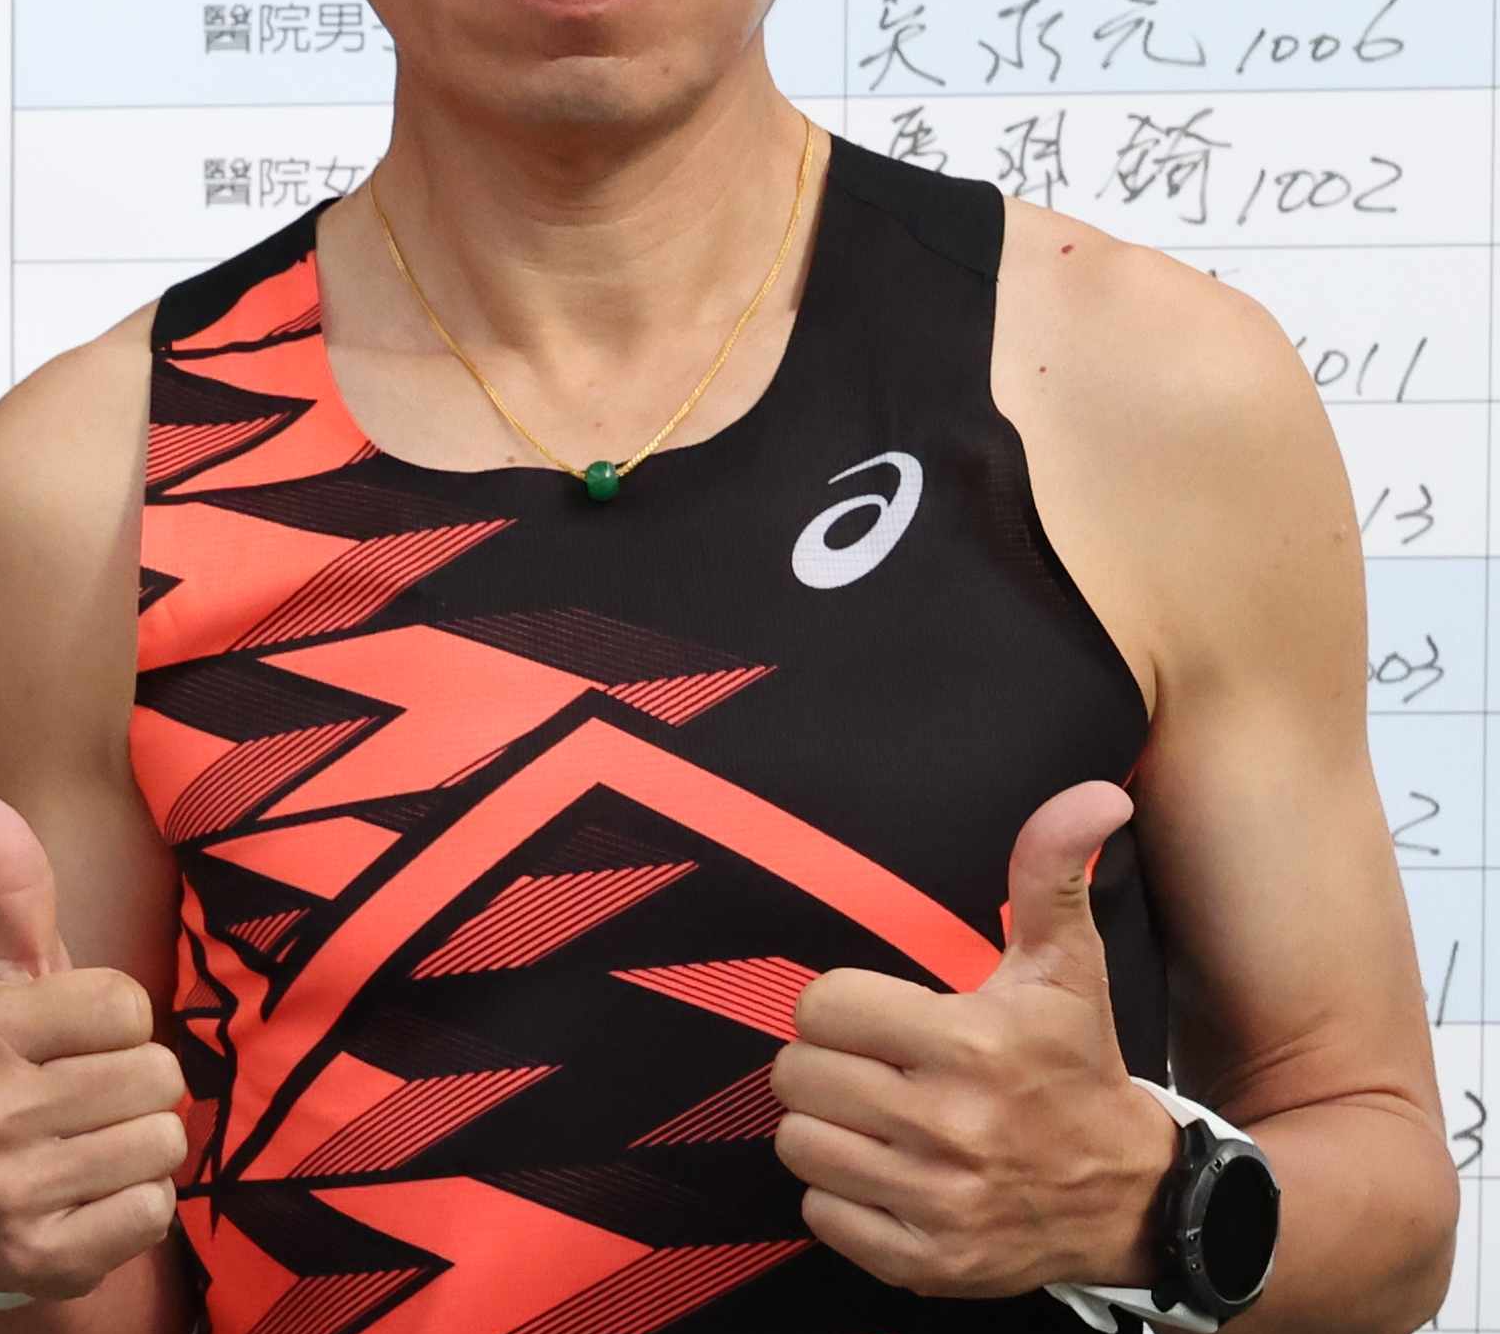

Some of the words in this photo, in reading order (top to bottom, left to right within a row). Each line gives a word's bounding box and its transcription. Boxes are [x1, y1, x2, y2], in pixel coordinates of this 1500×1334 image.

[203, 156, 385, 207] 醫院女
[1237, 156, 1404, 225] 1002
[1296, 335, 1428, 403] 011
